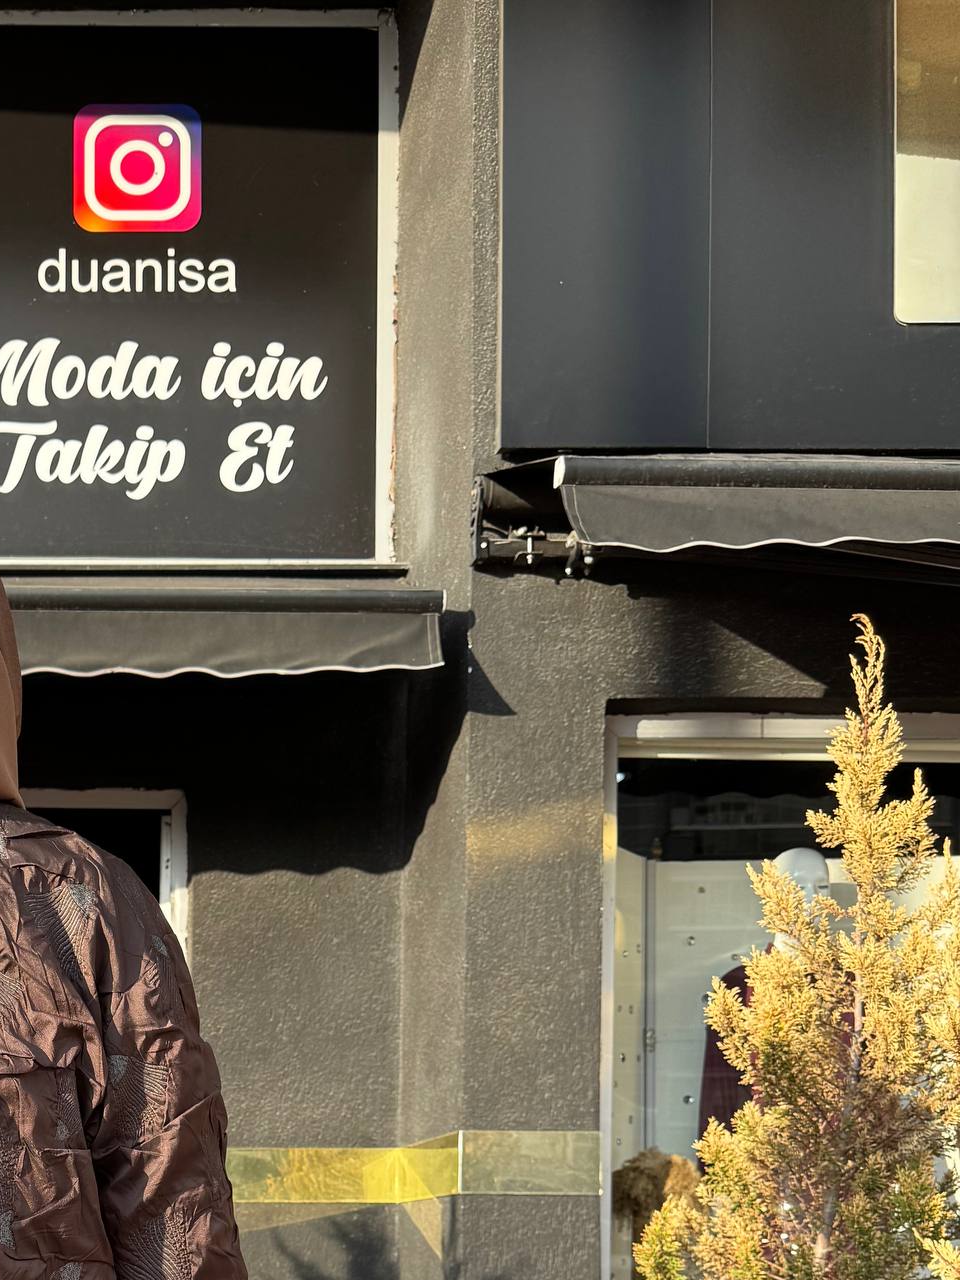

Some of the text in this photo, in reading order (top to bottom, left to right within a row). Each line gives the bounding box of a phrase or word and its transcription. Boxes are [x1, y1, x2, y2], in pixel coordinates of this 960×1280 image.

[37, 247, 237, 294] duanisa
[200, 341, 329, 409] için
[218, 421, 296, 493] Et
